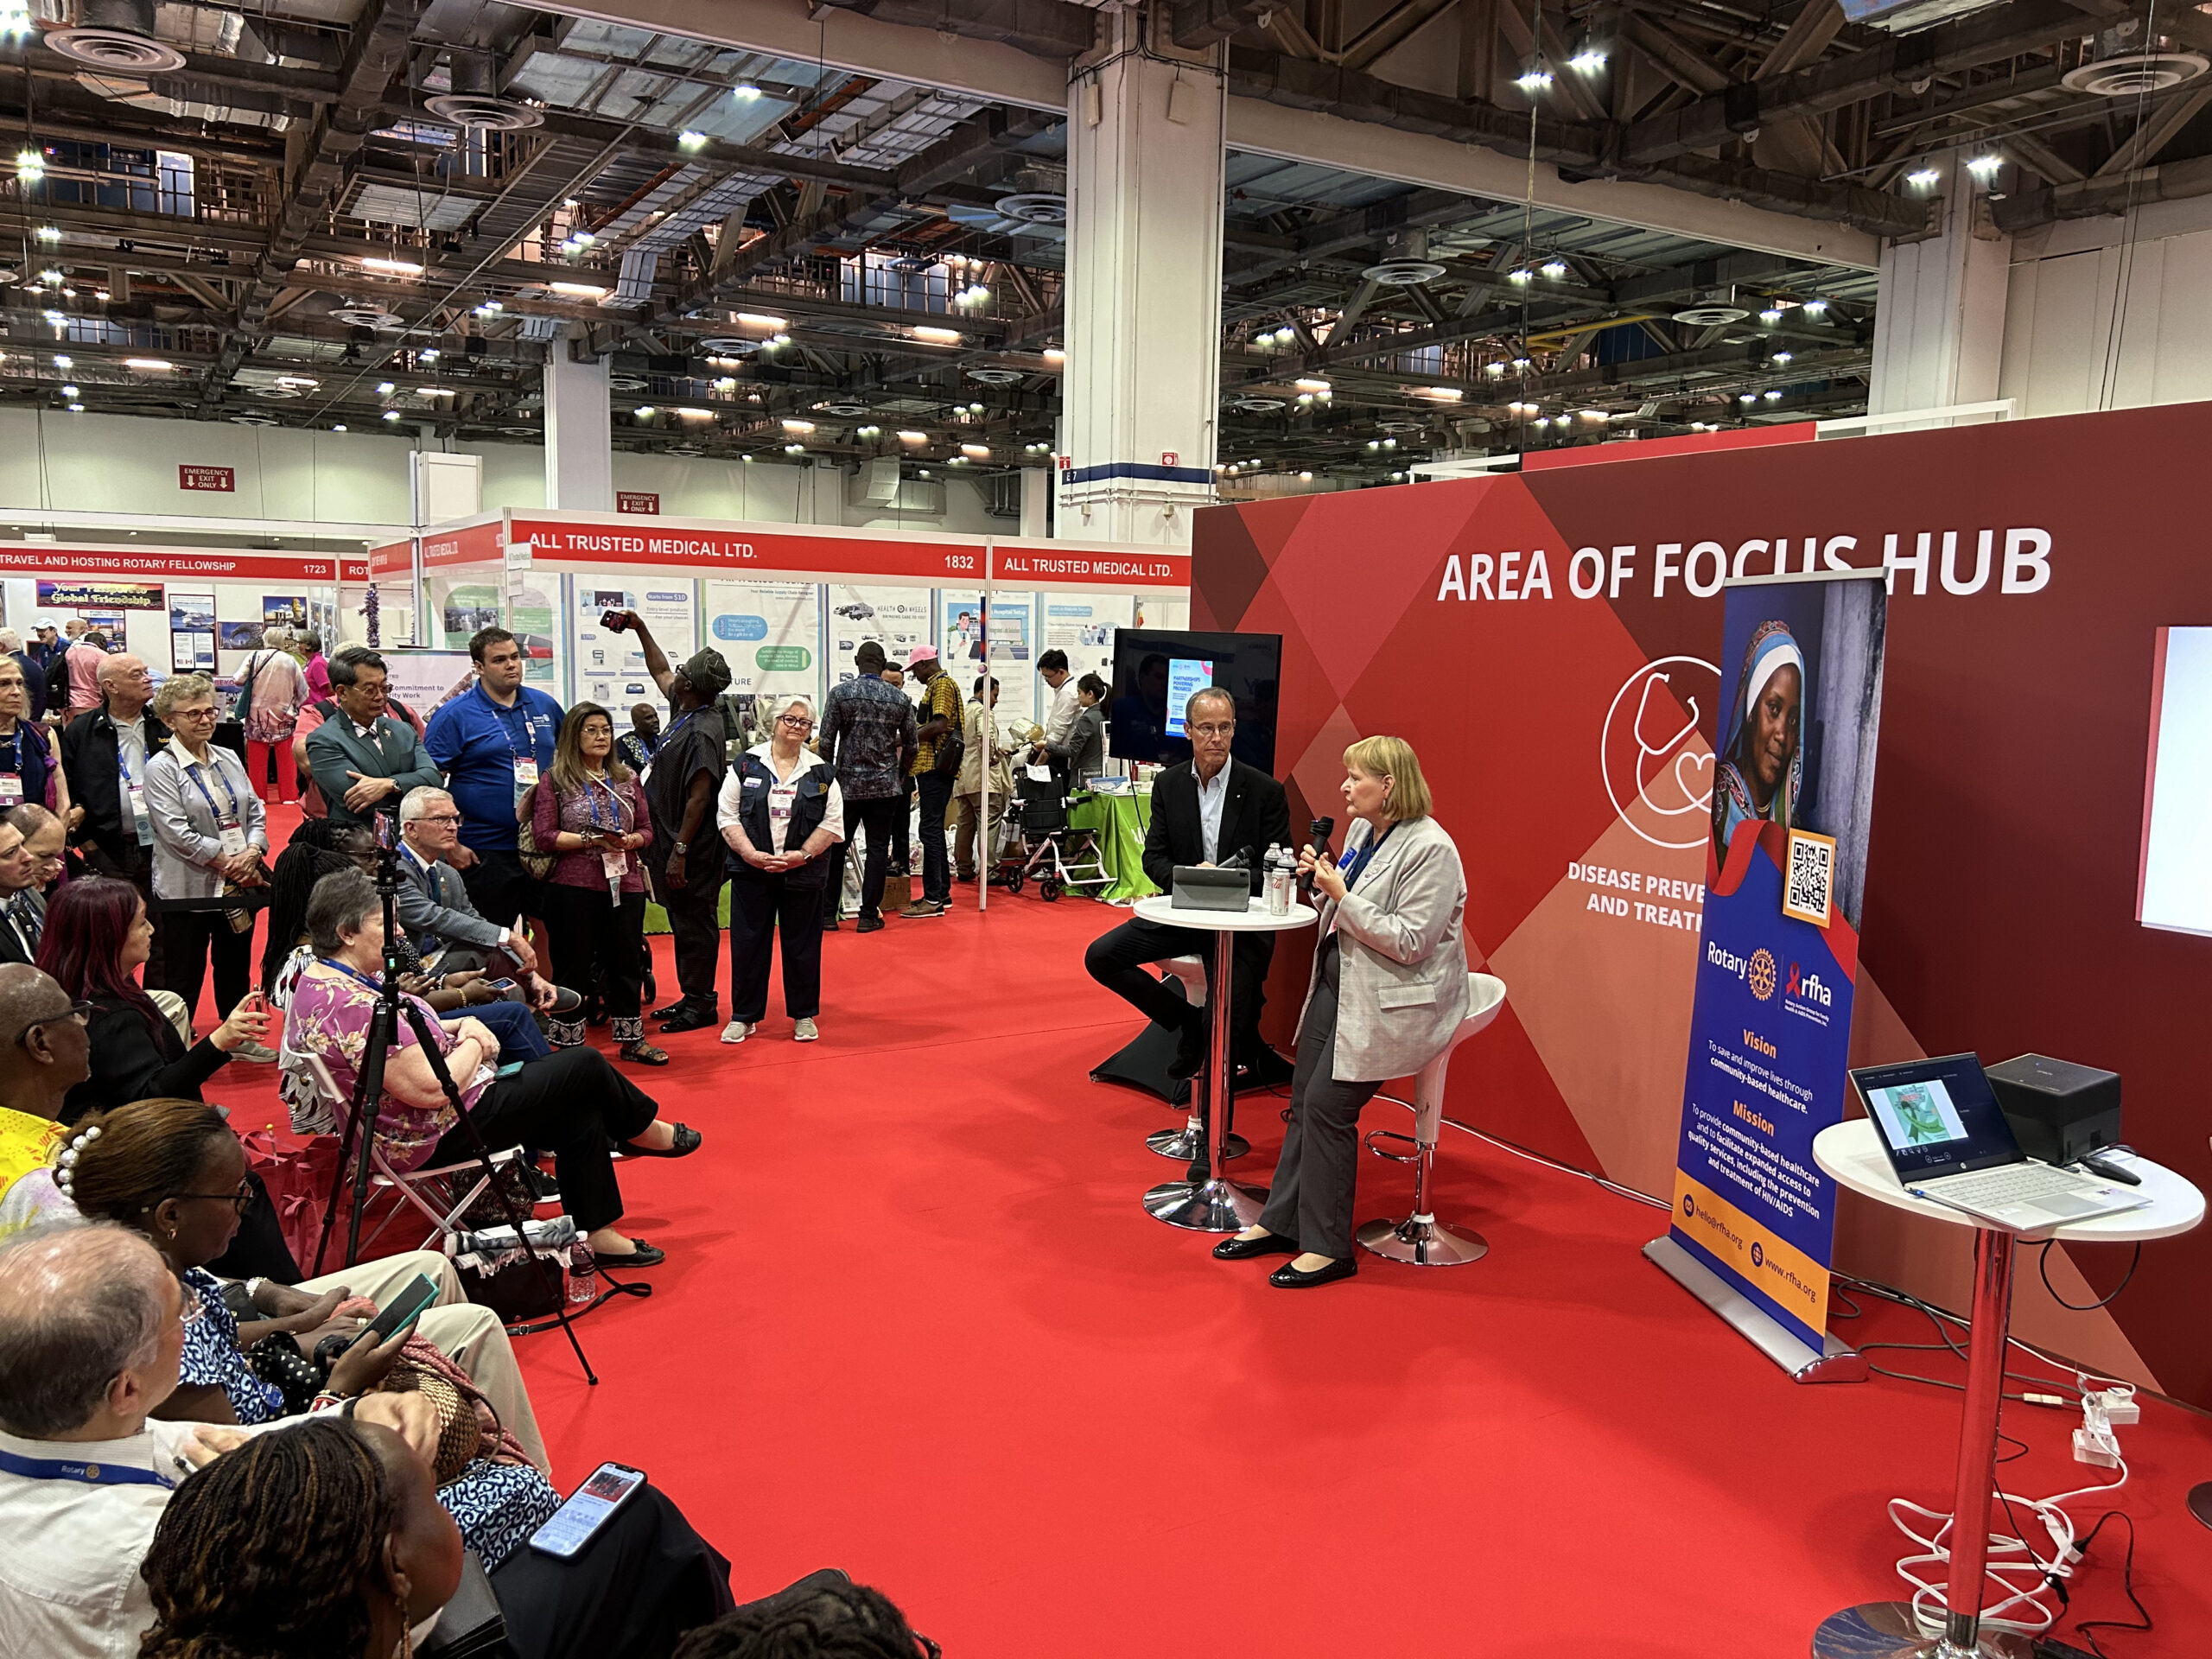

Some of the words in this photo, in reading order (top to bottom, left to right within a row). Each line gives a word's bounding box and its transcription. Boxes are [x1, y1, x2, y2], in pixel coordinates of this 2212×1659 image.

[184, 467, 229, 476] EMERGENCY
[1066, 472, 1071, 482] E
[1073, 471, 1077, 481] 7
[0, 554, 42, 565] TRAVEL
[44, 556, 69, 566] AND
[71, 557, 121, 568] HOSTING
[123, 558, 167, 569] ROTARY
[169, 559, 236, 571] FELLOWSHIP
[530, 533, 562, 549] ALL
[566, 534, 645, 553] TRUSTED
[649, 539, 721, 556] MEDICAL
[725, 543, 758, 559] LTD.
[944, 555, 974, 569] 1832
[303, 564, 327, 574] 1723
[349, 566, 369, 575] ROT
[1004, 557, 1030, 572] ALL
[1032, 558, 1090, 574] TRUSTED
[1093, 561, 1146, 576] MEDICAL
[1148, 563, 1174, 577] LTD.
[1437, 550, 1554, 601] AREA
[1568, 545, 1637, 599] OF
[1653, 535, 1858, 598] FOCUS
[1883, 527, 2052, 595] HUB
[51, 593, 89, 604] Global
[90, 594, 151, 605] Friendship
[52, 582, 81, 593] Your
[1568, 861, 1642, 892] DISEASE
[1646, 875, 1705, 904] PREVE
[1586, 893, 1629, 917] AND
[1634, 901, 1703, 933] TREAT
[1707, 941, 1748, 980] Rotary
[1801, 974, 1831, 1007] rfha
[1743, 1029, 1777, 1059] Vision
[1708, 1039, 1716, 1052] To
[1717, 1046, 1730, 1059] save
[1731, 1052, 1743, 1065] and
[1744, 1058, 1770, 1079] improve
[1770, 1070, 1783, 1087] lives
[1784, 1079, 1813, 1101] through
[1710, 1057, 1767, 1093] community-based
[1768, 1084, 1808, 1114] healthcare.
[1733, 1100, 1774, 1137] Mission
[1692, 1103, 1699, 1115] To
[1699, 1110, 1722, 1128] provide
[1722, 1123, 1779, 1163] community-based
[1781, 1155, 1819, 1188] healthcare
[1697, 1122, 1708, 1135] and
[1710, 1129, 1716, 1138] to
[1716, 1131, 1744, 1156] facilitate
[1745, 1151, 1777, 1177] expanded
[1777, 1171, 1802, 1192] access
[1803, 1185, 1811, 1197] to
[1688, 1130, 1709, 1150] quality
[1710, 1143, 1735, 1167] services,
[1737, 1158, 1767, 1187] including
[1767, 1179, 1778, 1193] the
[1780, 1188, 1820, 1219] prevention
[1708, 1157, 1719, 1170] and
[1720, 1163, 1753, 1192] treatment
[1754, 1186, 1762, 1198] of
[1762, 1189, 1794, 1217] HIV/AIDS
[1696, 1205, 1743, 1250] hello@rfha.org
[1765, 1257, 1816, 1303] www.rfha.org
[61, 1465, 85, 1475] Rotary
